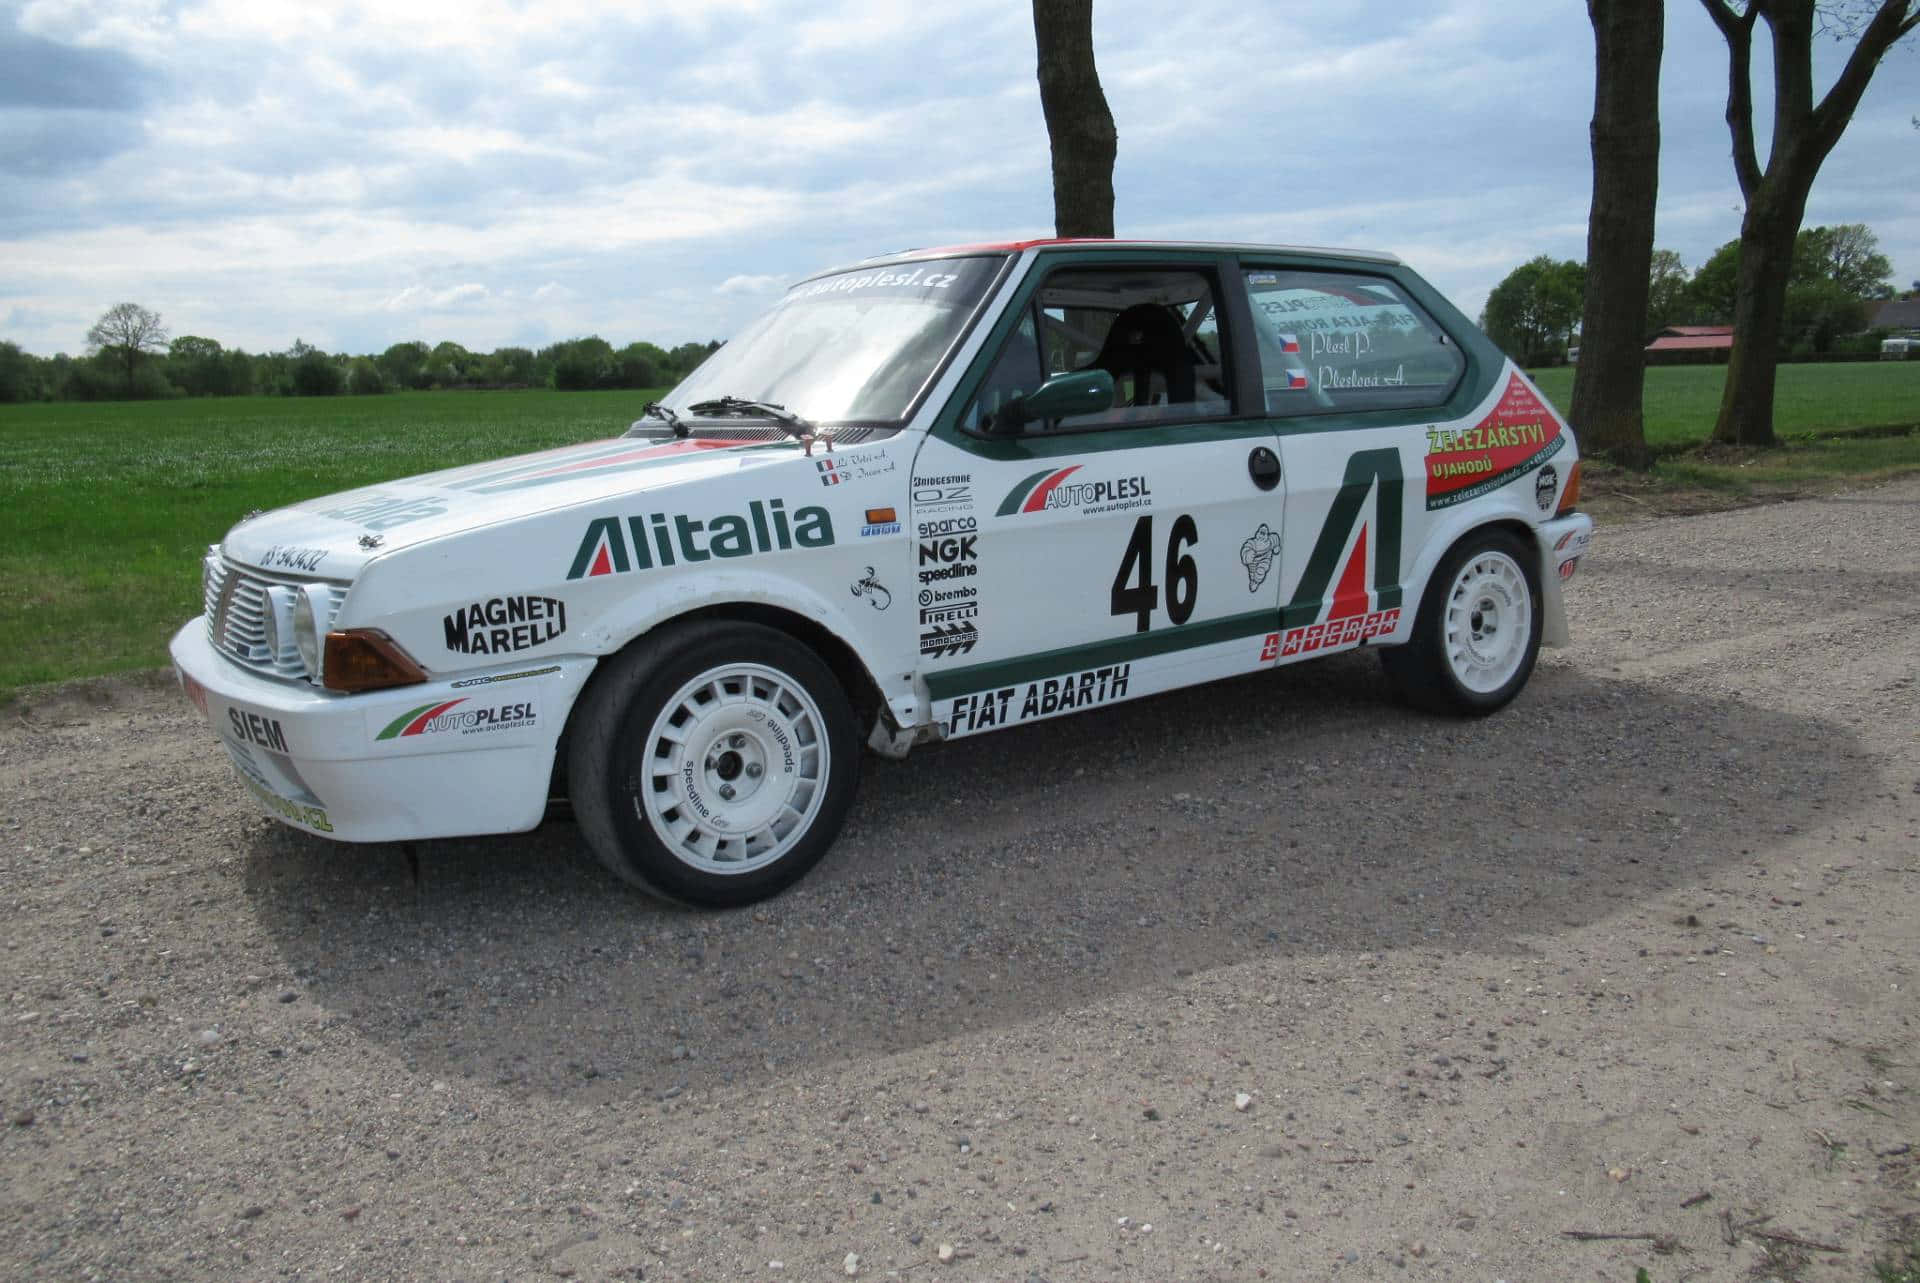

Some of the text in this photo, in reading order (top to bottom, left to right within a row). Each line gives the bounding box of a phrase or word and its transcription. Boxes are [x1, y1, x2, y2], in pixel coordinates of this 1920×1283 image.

[1425, 418, 1546, 454] ŽELEZÁŘSTVÍ
[913, 474, 971, 487] BRIDGESTONE
[913, 486, 972, 502] OZ
[1043, 476, 1152, 511] AUTOPLESL
[1083, 498, 1153, 515] www.autoplesl.cz
[565, 498, 835, 581] Alitalia
[918, 516, 978, 538] sparco
[919, 535, 978, 566] NGK
[918, 563, 977, 585] speedline
[1110, 513, 1199, 633] 46
[934, 587, 977, 602] brembo
[443, 596, 567, 634] MAGNETI
[919, 601, 978, 625] PIRELLI
[444, 610, 567, 655] MARELLI
[950, 663, 1131, 735] FIAT ABARTH
[228, 706, 290, 753] SIEM
[422, 702, 537, 735] AUTOPLESL
[461, 719, 536, 736] www.autoplesl.cz
[767, 718, 795, 774] speedline
[682, 759, 710, 818] speedline
